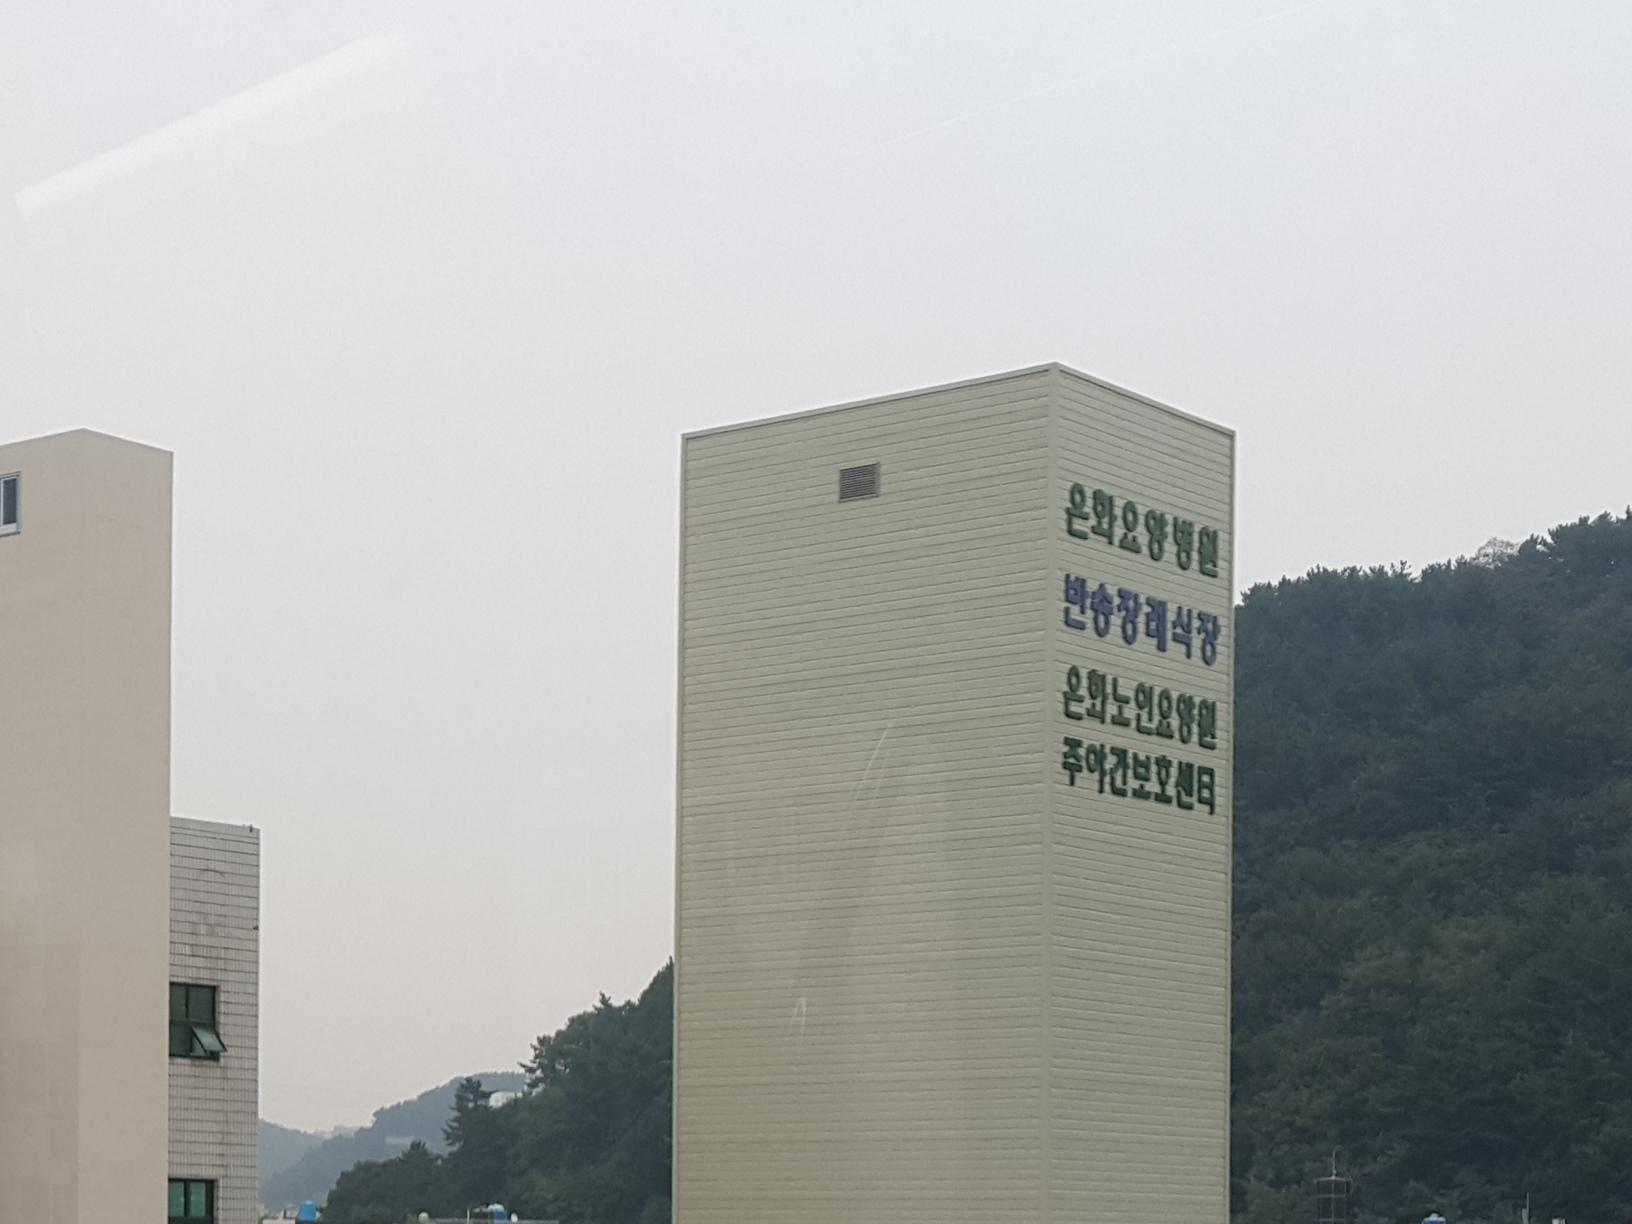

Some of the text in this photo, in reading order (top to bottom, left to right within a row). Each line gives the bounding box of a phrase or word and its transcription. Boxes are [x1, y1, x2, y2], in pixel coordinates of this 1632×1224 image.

[1066, 482, 1219, 578] 은화요양병원
[1064, 572, 1221, 667] 반송장례식장
[1062, 664, 1218, 751] 은화노인요양원
[1061, 735, 1217, 816] 주야간보호센터
